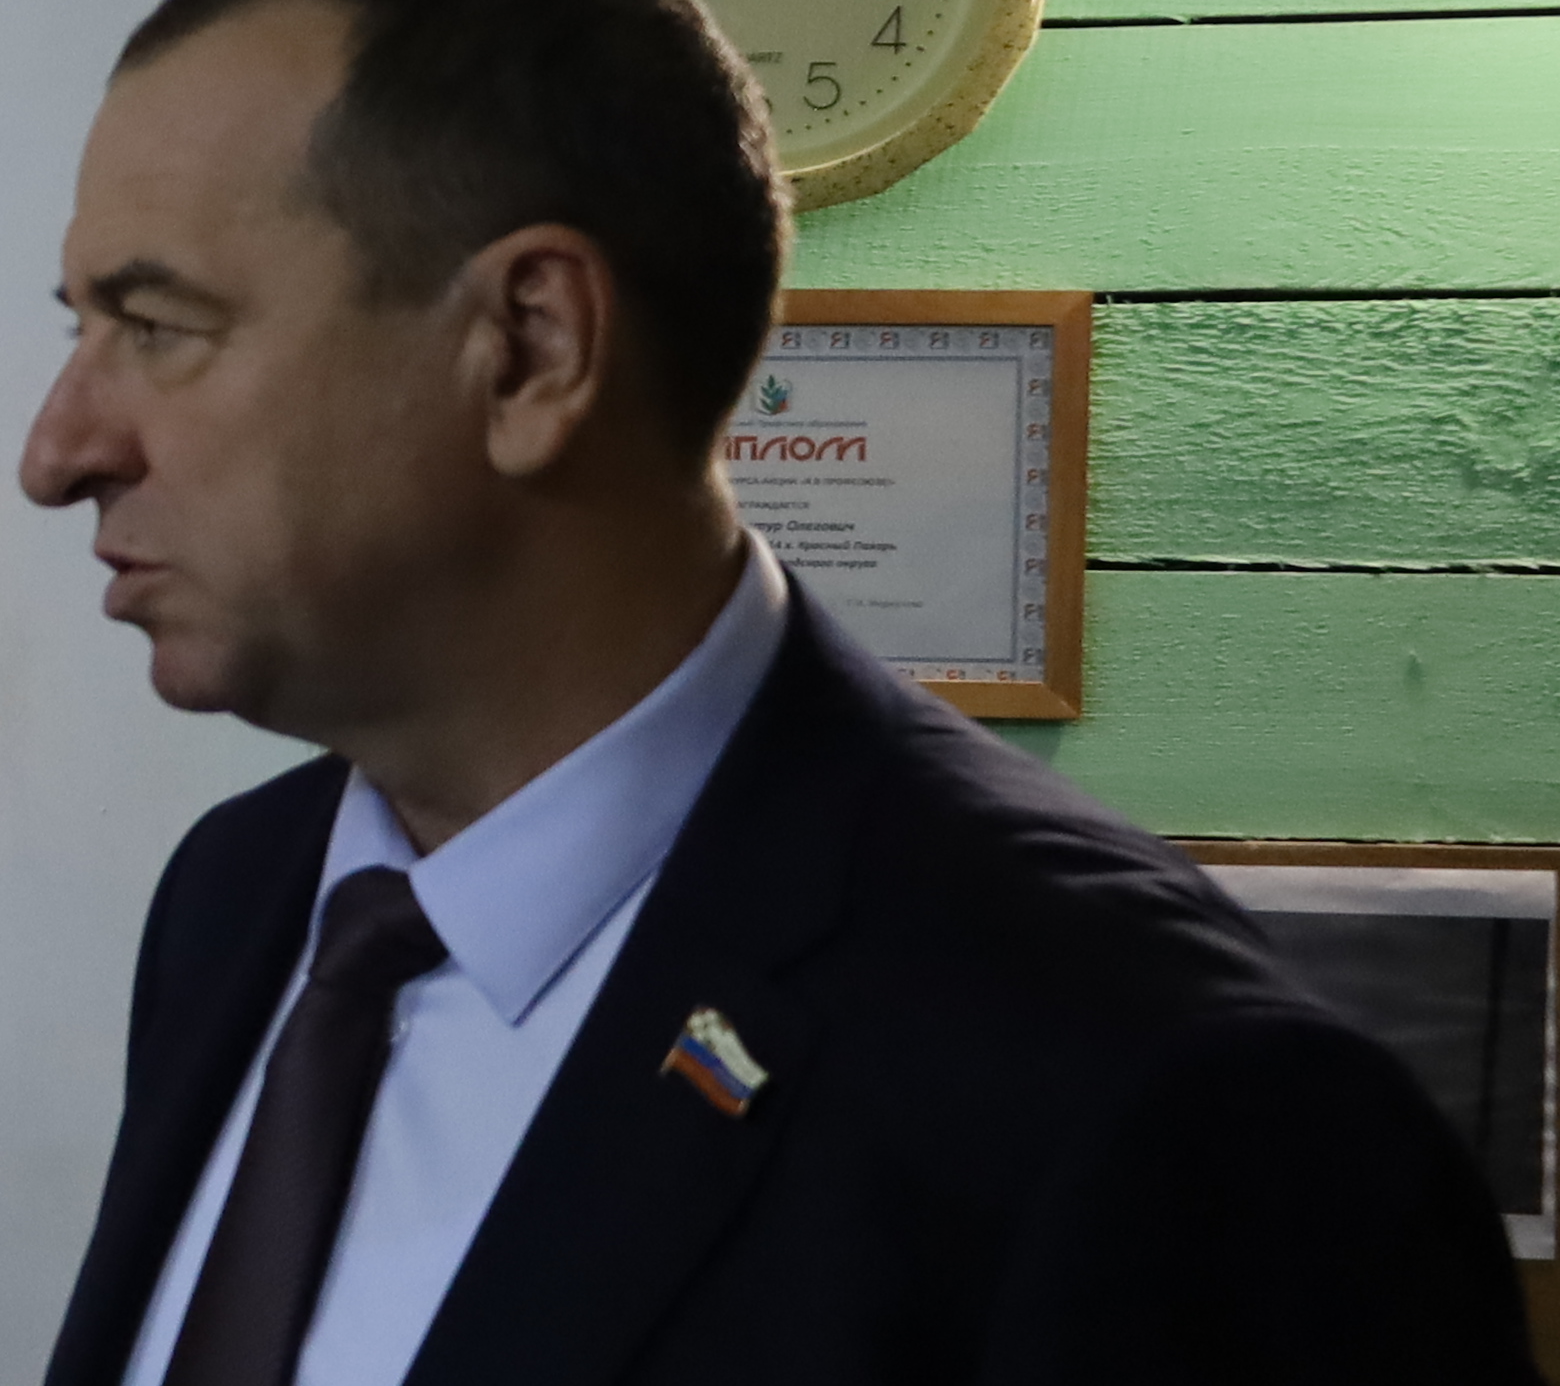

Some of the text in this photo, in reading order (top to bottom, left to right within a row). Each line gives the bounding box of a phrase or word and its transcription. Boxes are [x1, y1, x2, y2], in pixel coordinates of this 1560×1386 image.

[870, 5, 907, 55] 4
[747, 52, 783, 63] ARTZ
[803, 61, 842, 110] 5
[725, 436, 867, 461] ПЛОМ
[738, 502, 809, 510] АГРАЖДАЕТСЯ
[751, 520, 856, 533] тур Олегович
